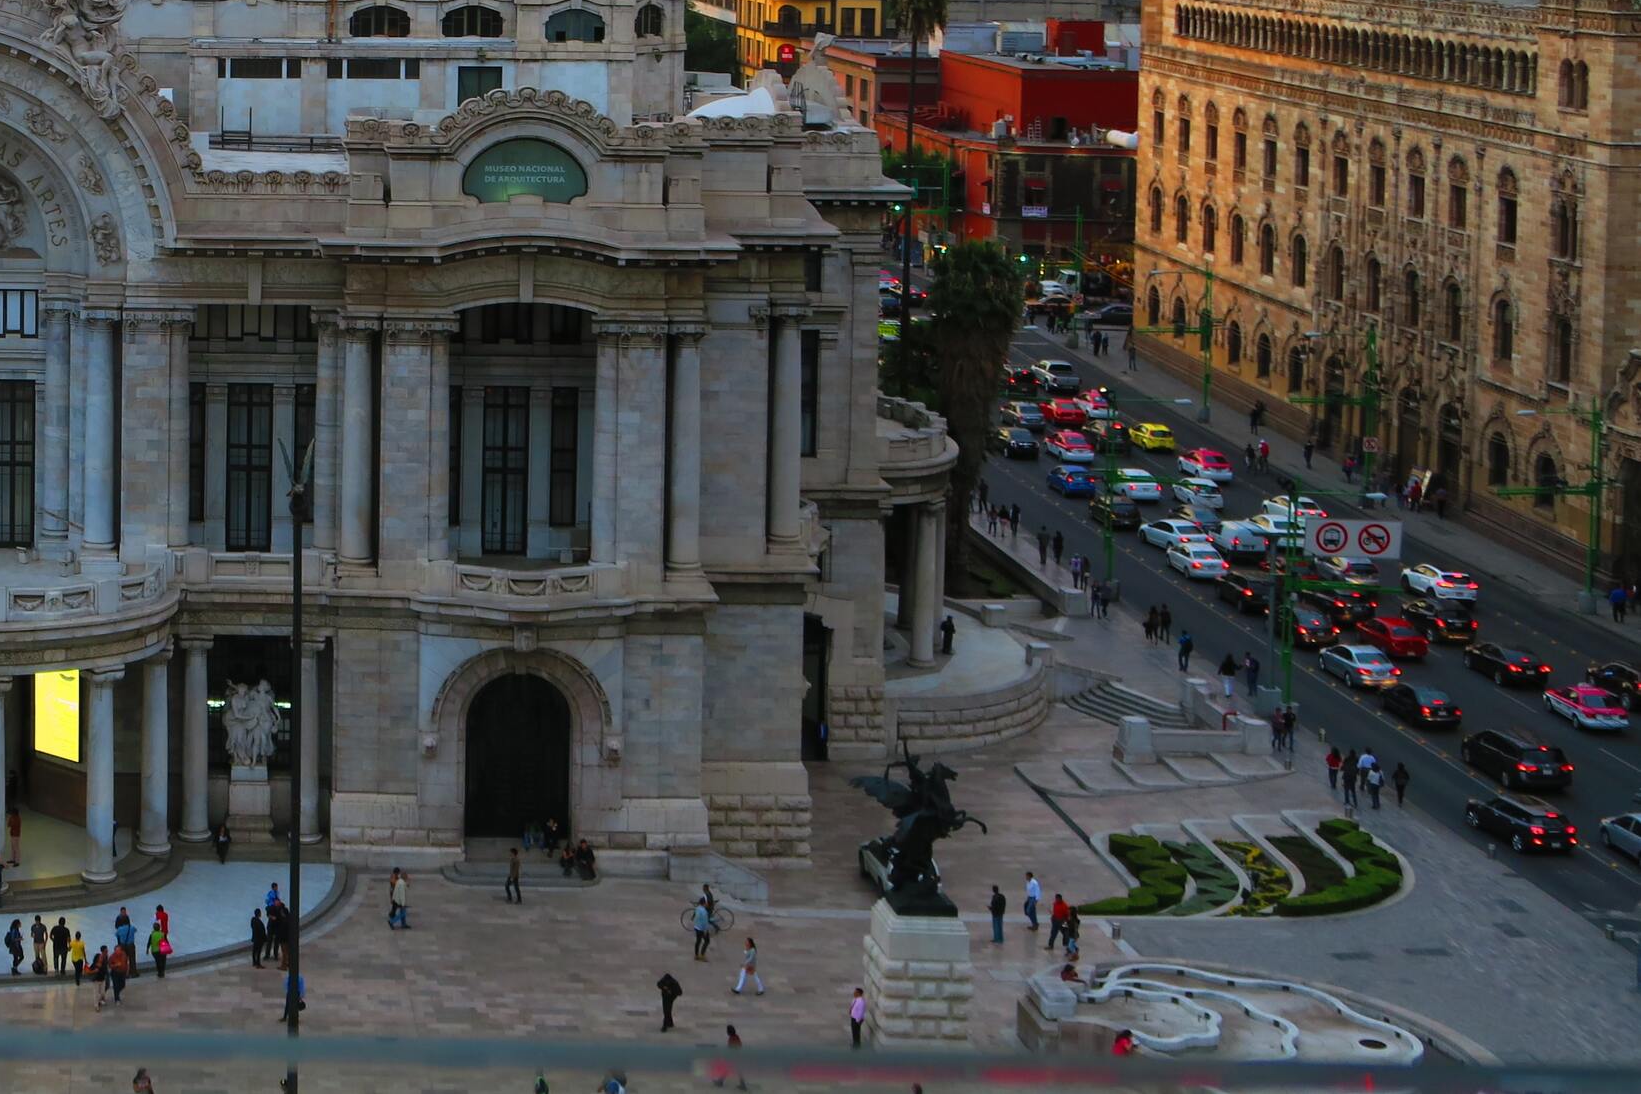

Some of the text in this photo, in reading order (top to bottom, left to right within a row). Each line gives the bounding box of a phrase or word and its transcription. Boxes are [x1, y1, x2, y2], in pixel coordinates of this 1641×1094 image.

[484, 165, 566, 173] MUSEO NACIONAL
[484, 175, 566, 183] DE ARQUITECTURA
[26, 175, 69, 249] ARTES
